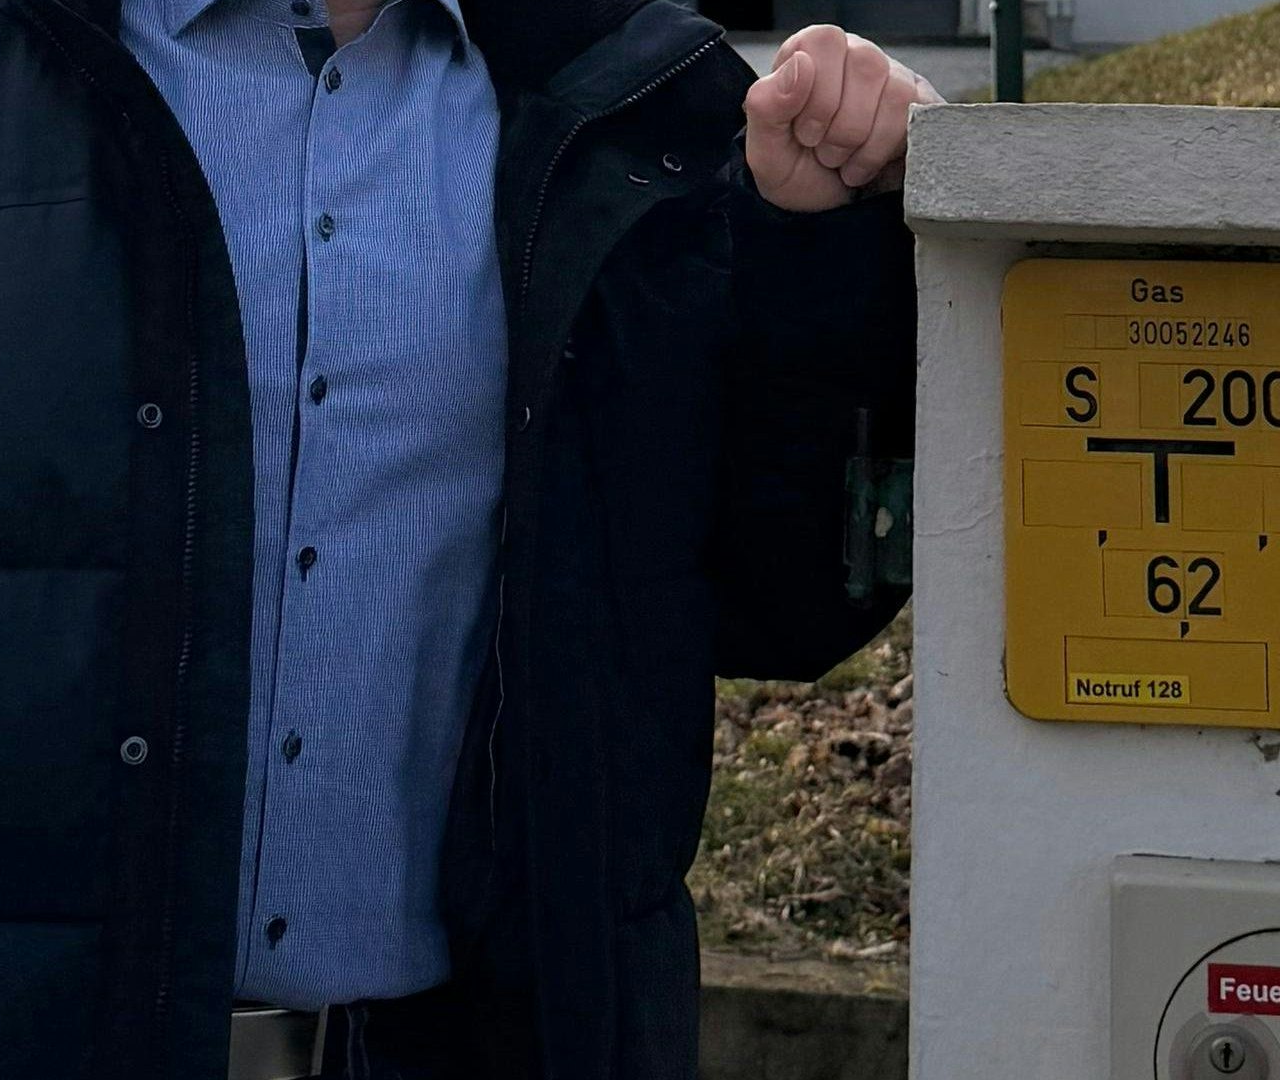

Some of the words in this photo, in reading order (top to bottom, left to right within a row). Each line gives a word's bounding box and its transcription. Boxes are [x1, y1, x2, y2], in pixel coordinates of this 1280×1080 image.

[1130, 278, 1184, 304] Gas
[1129, 320, 1250, 348] 30052246
[1064, 365, 1099, 423] S
[1075, 678, 1140, 699] Notruf
[1146, 681, 1183, 700] 128
